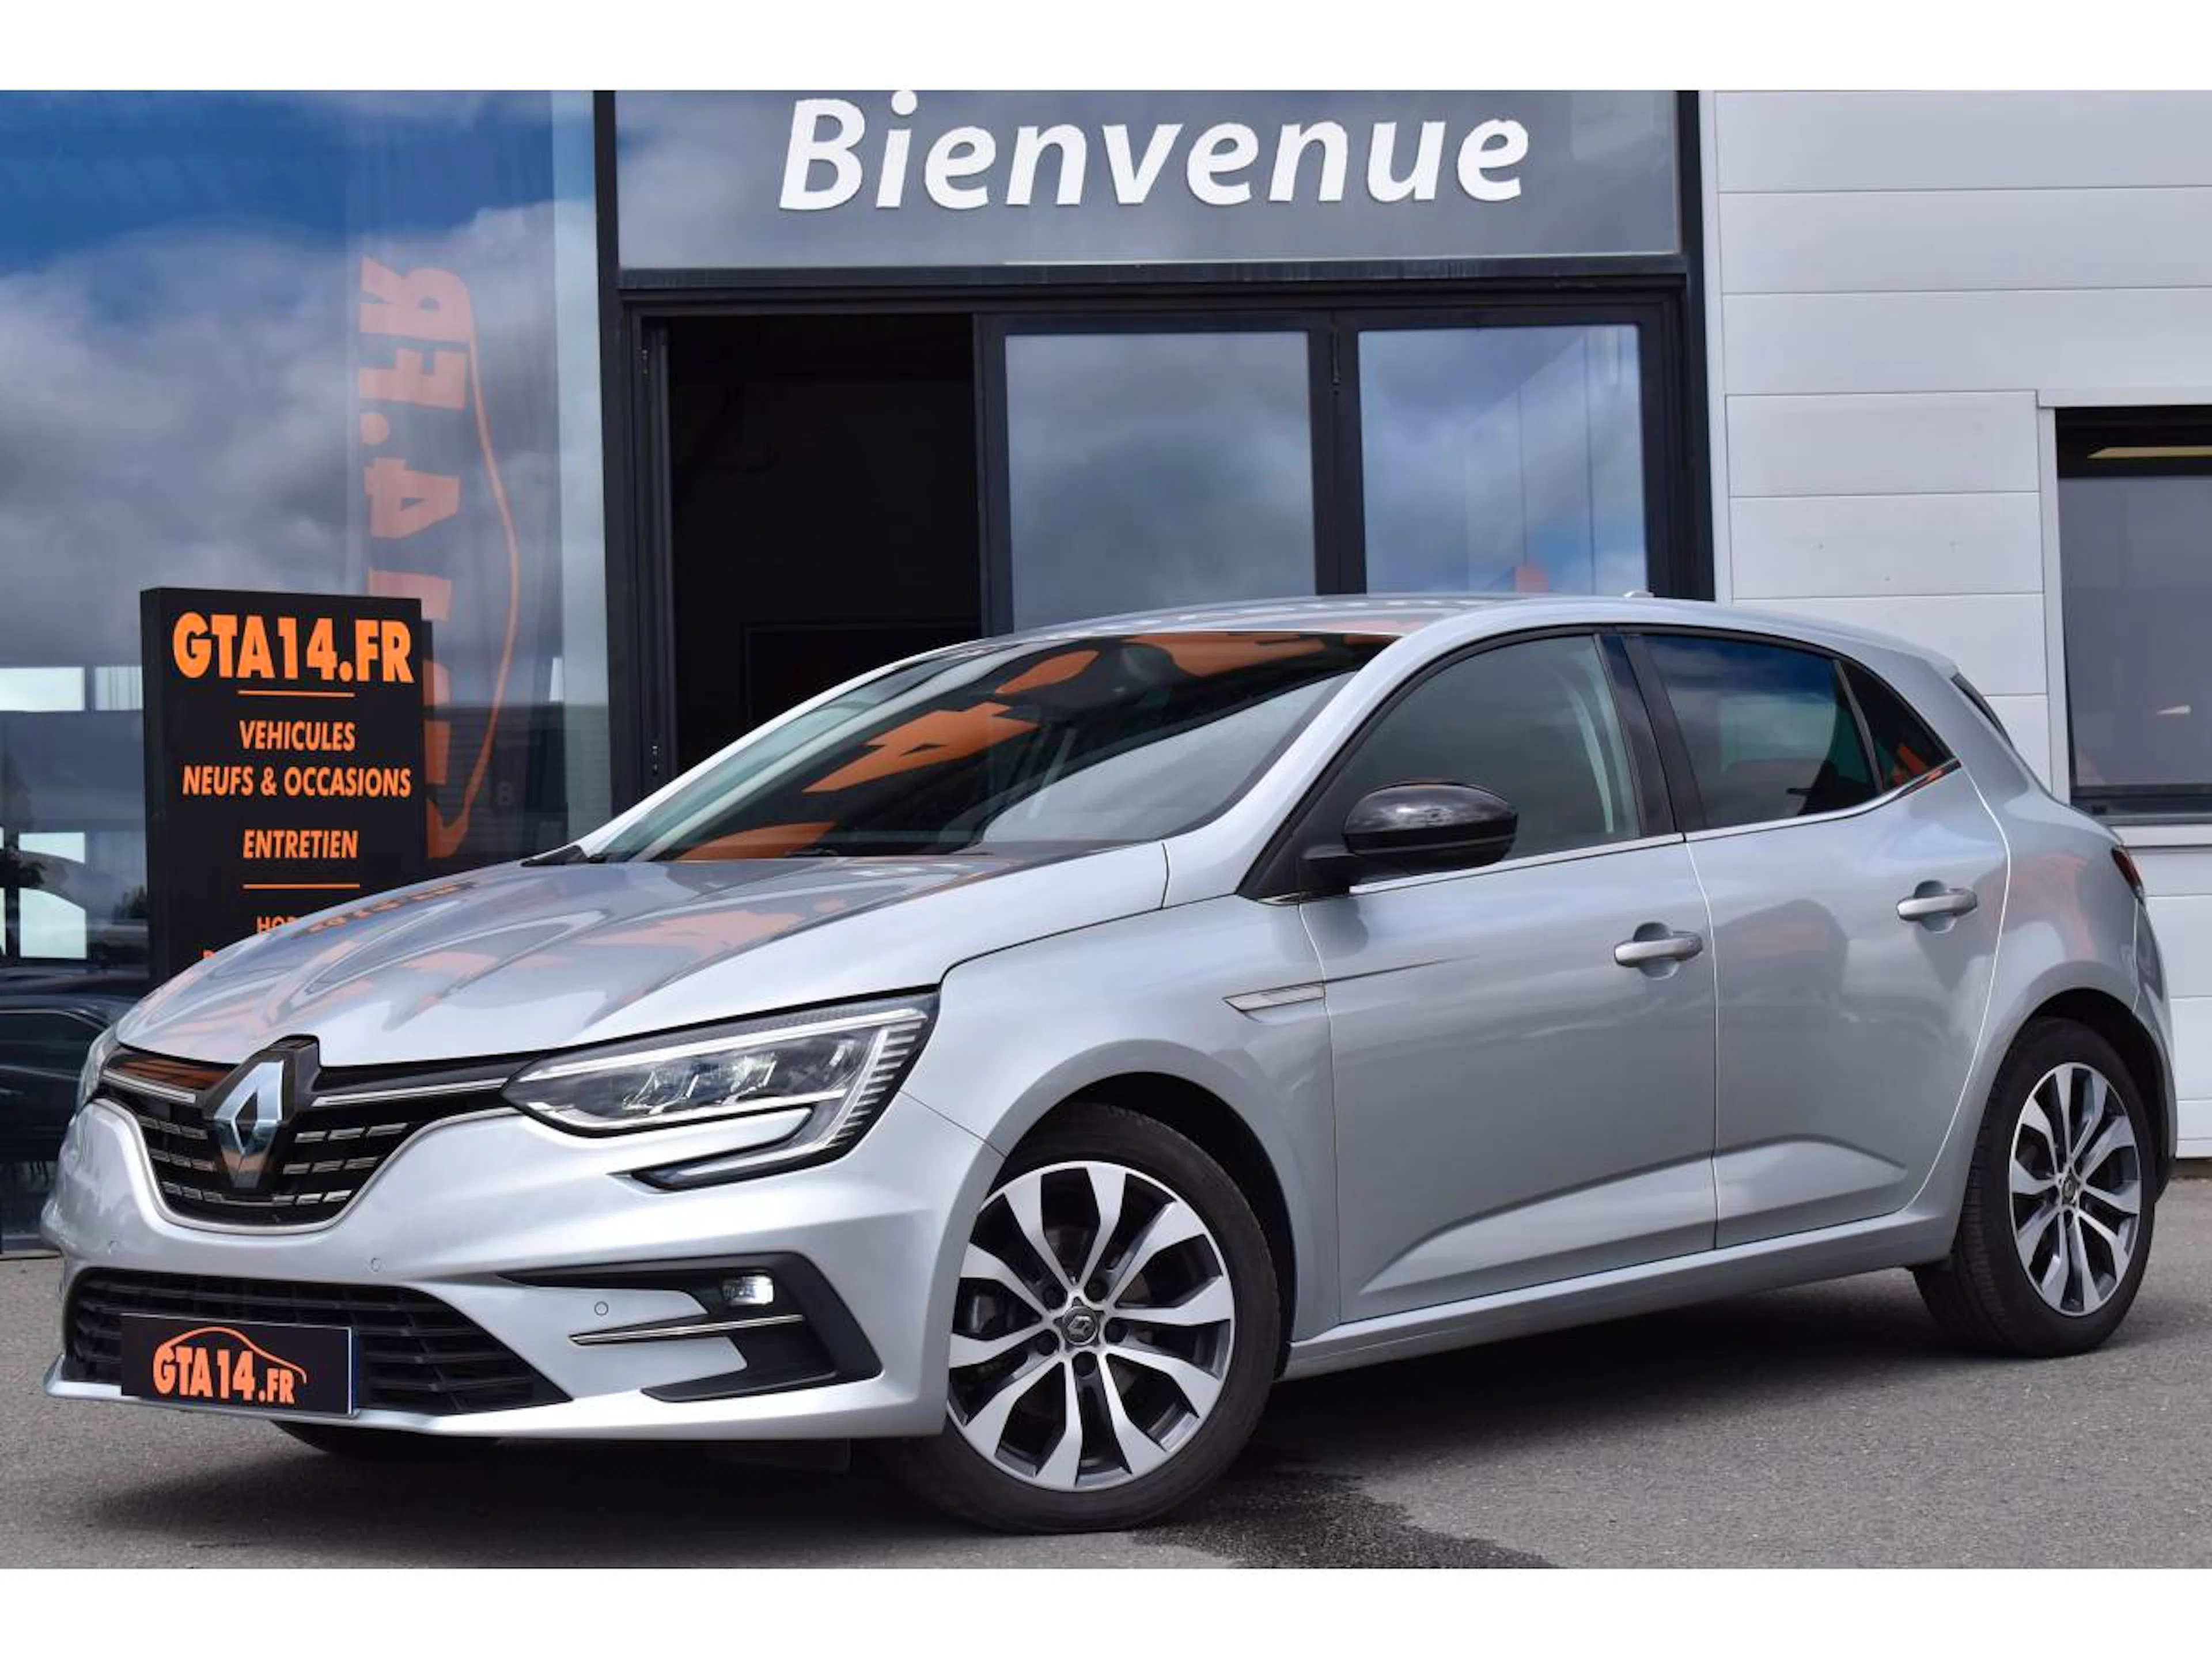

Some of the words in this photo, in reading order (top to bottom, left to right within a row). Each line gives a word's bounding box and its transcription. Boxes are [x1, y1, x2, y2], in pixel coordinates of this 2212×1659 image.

[779, 90, 1529, 210] Bienvenue
[172, 612, 414, 683] GTA14.FR
[239, 719, 355, 751] VEHICULES
[182, 765, 254, 796] NEUFS
[260, 766, 277, 796] &
[283, 766, 411, 798] OCCASIONS
[243, 829, 358, 858] ENTRETIEN
[153, 1343, 296, 1404] GTA14.FR
